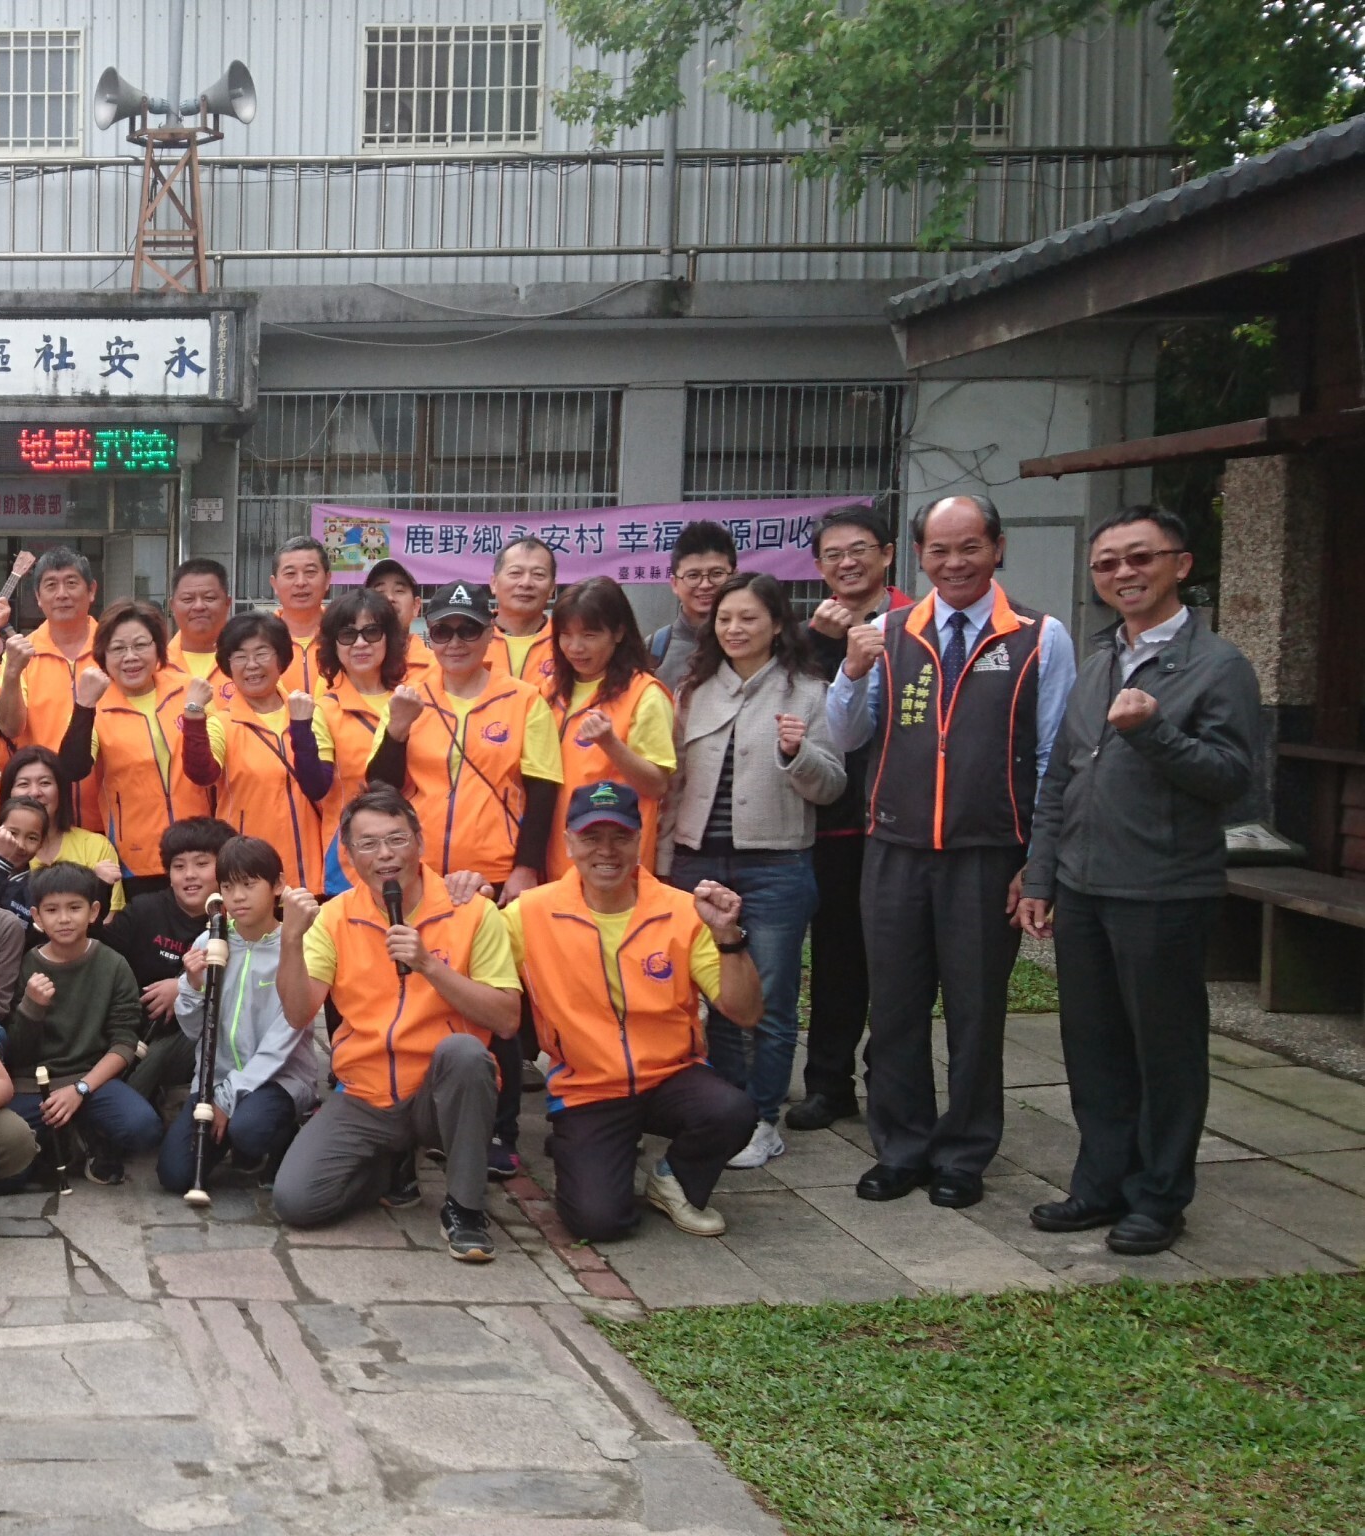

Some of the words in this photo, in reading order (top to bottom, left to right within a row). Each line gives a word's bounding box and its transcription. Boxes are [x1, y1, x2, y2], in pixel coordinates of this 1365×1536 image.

[617, 516, 813, 553] 幸福源回收
[450, 585, 472, 600] A
[159, 949, 180, 960] KEEP
